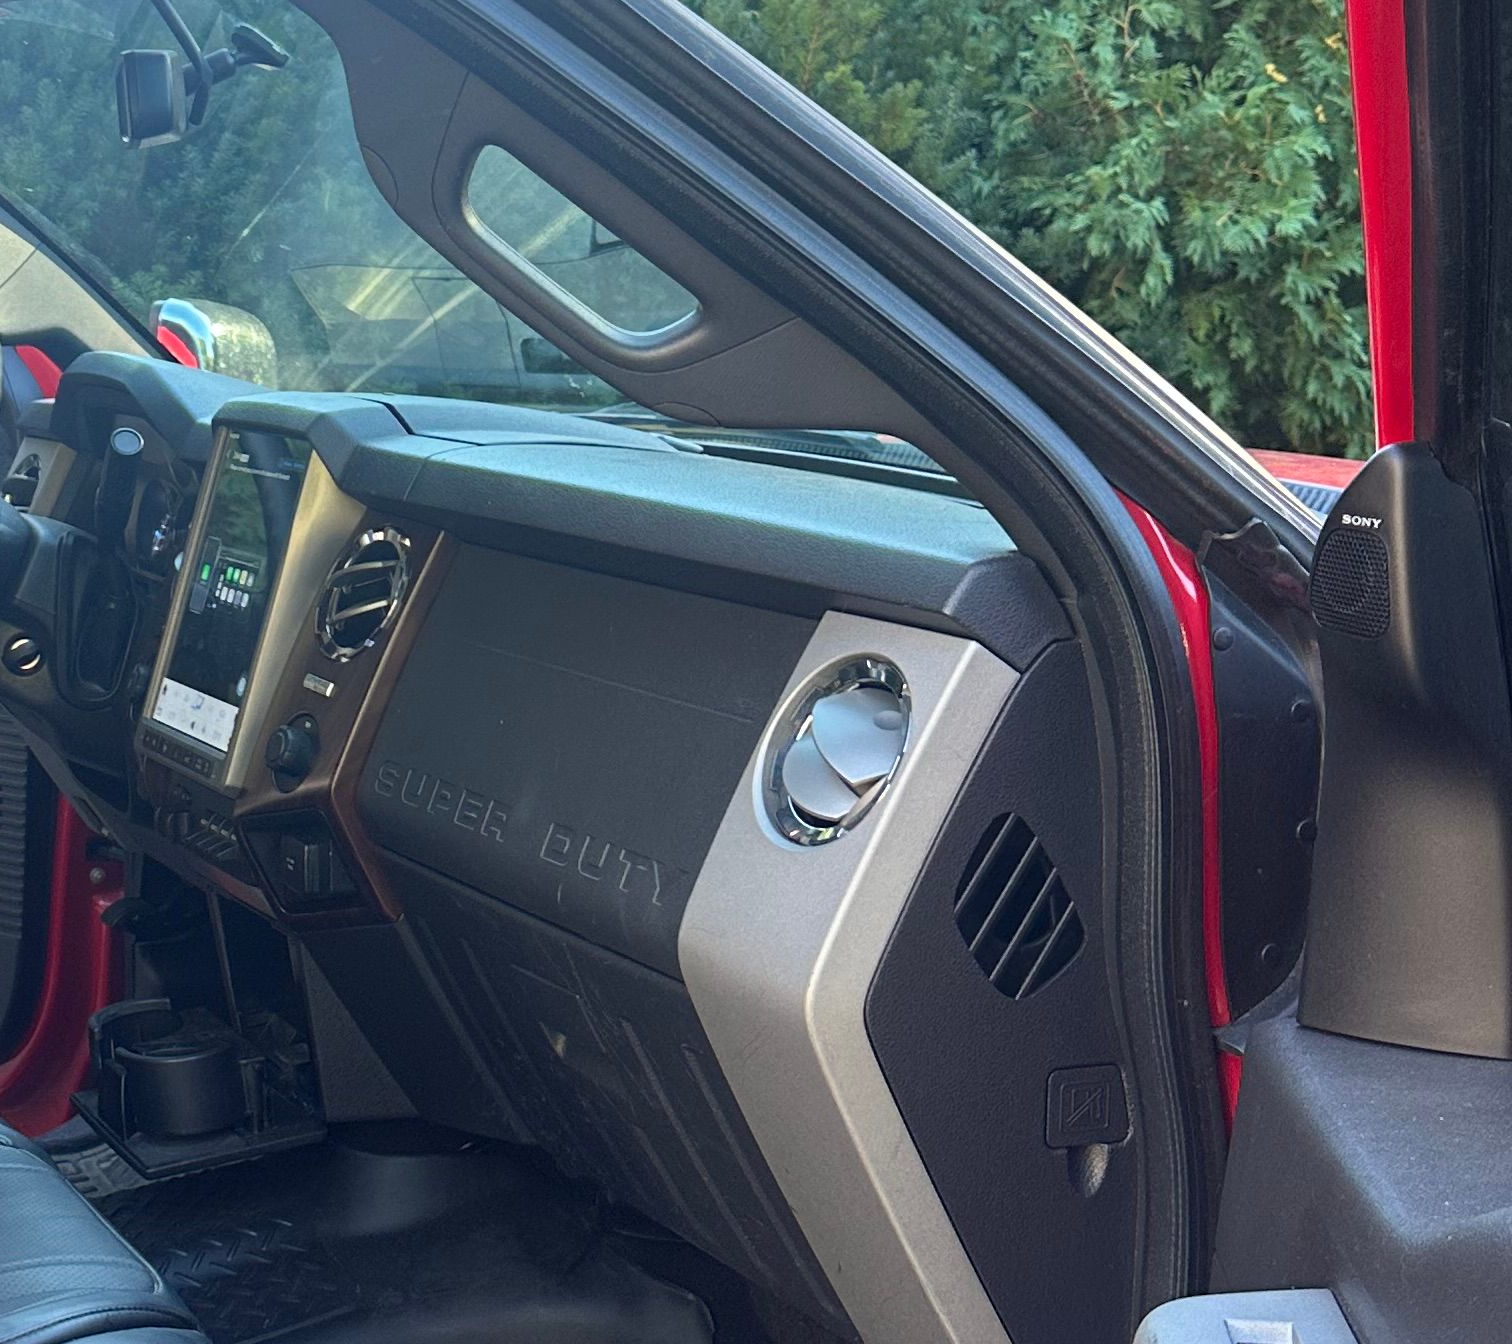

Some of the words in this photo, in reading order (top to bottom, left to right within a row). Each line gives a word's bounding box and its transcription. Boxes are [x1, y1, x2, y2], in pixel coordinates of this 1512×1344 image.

[1341, 513, 1382, 529] SONY
[374, 760, 508, 843] SUPER
[539, 822, 686, 906] DUTY
